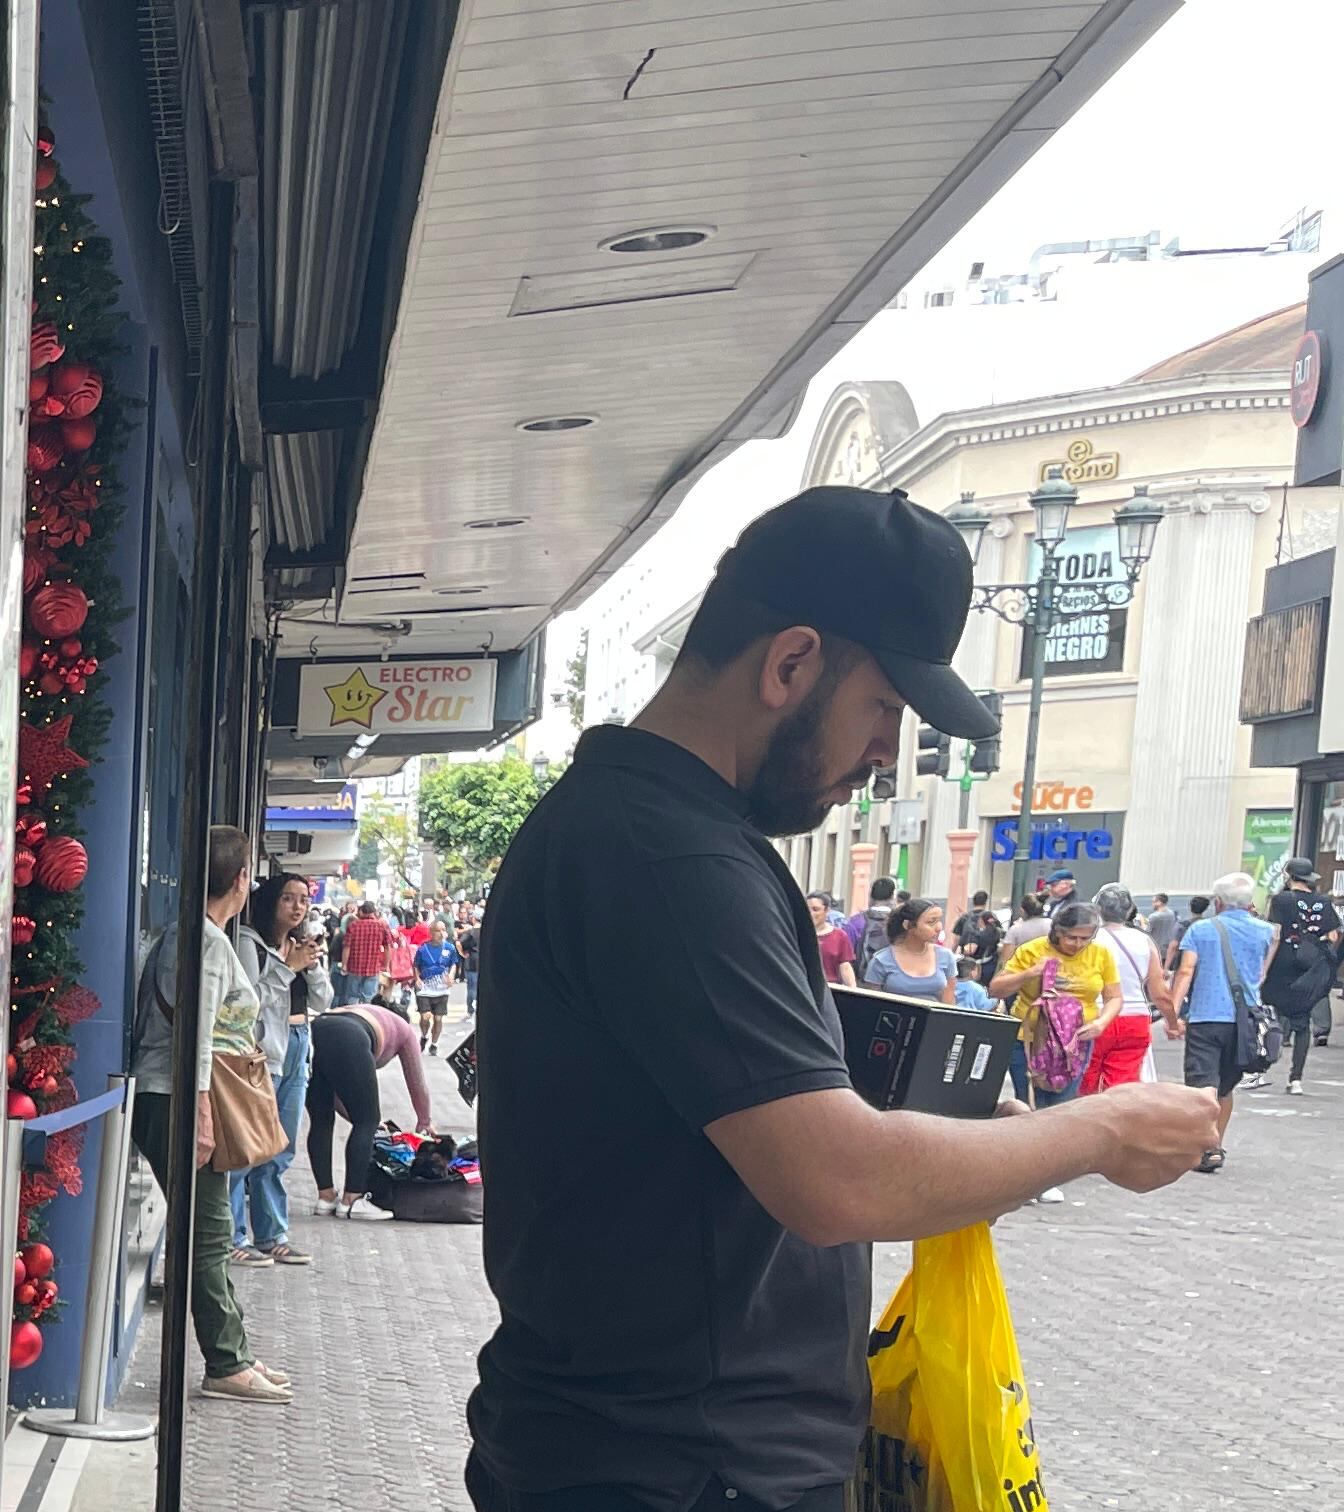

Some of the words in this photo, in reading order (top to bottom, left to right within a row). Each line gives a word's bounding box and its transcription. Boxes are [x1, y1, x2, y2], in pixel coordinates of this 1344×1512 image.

[1053, 551, 1113, 581] TODA
[1044, 635, 1109, 663] NEGRO
[379, 666, 472, 684] ELECTRO
[387, 685, 474, 723] Star
[1011, 781, 1094, 812] Sucre
